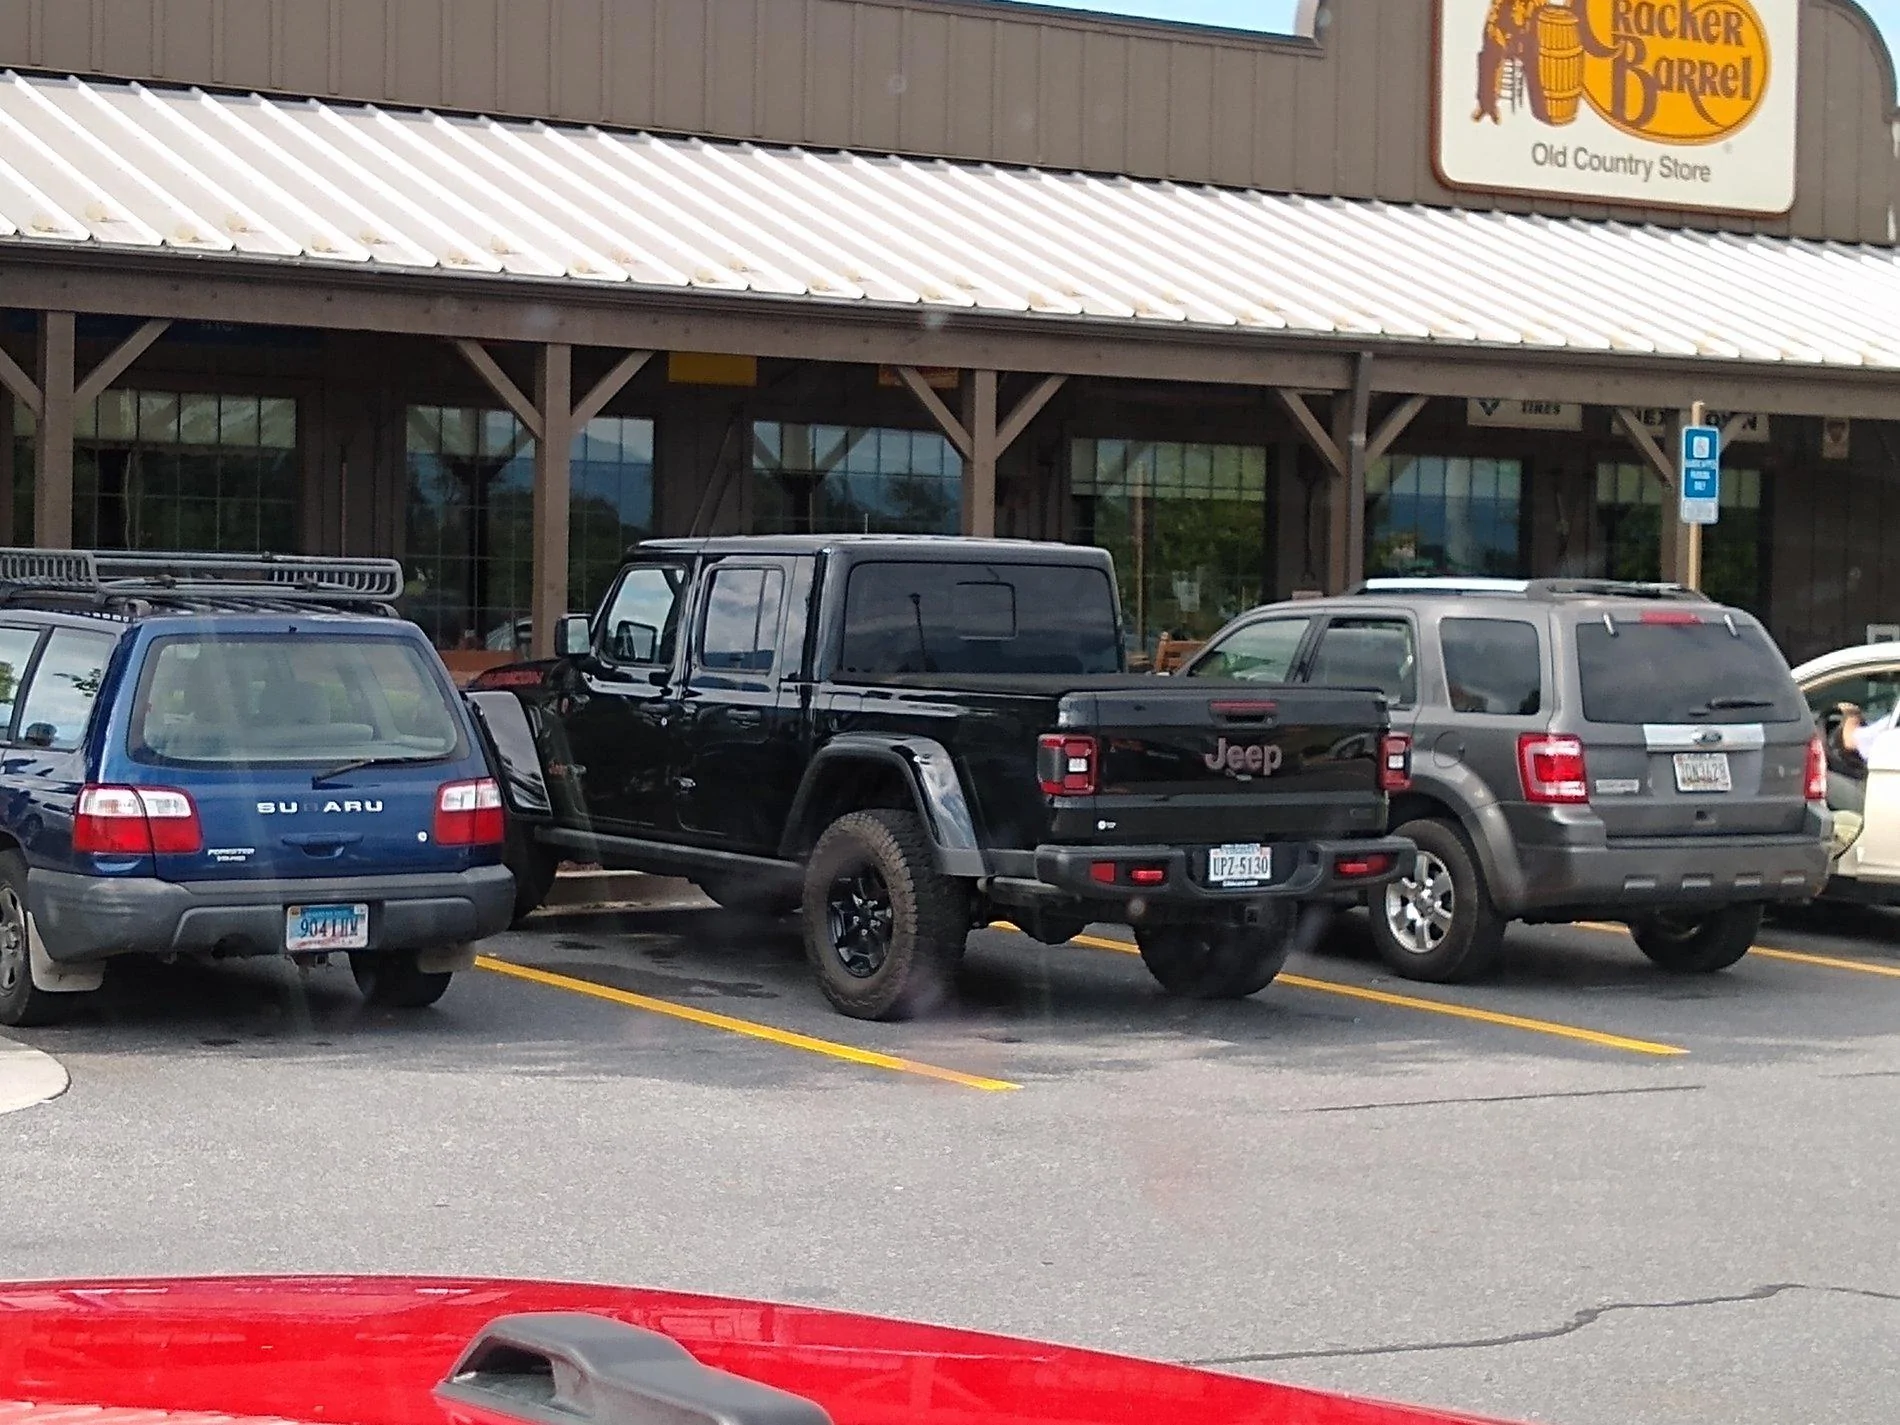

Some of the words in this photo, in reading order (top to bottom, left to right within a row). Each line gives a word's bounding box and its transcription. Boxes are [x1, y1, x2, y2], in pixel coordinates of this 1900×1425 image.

[1612, 33, 1752, 128] Barrel
[1531, 142, 1567, 169] Old
[1573, 147, 1653, 183] Country
[1659, 155, 1712, 182] Store
[1204, 737, 1284, 776] Jeep
[257, 800, 383, 814] SUARU
